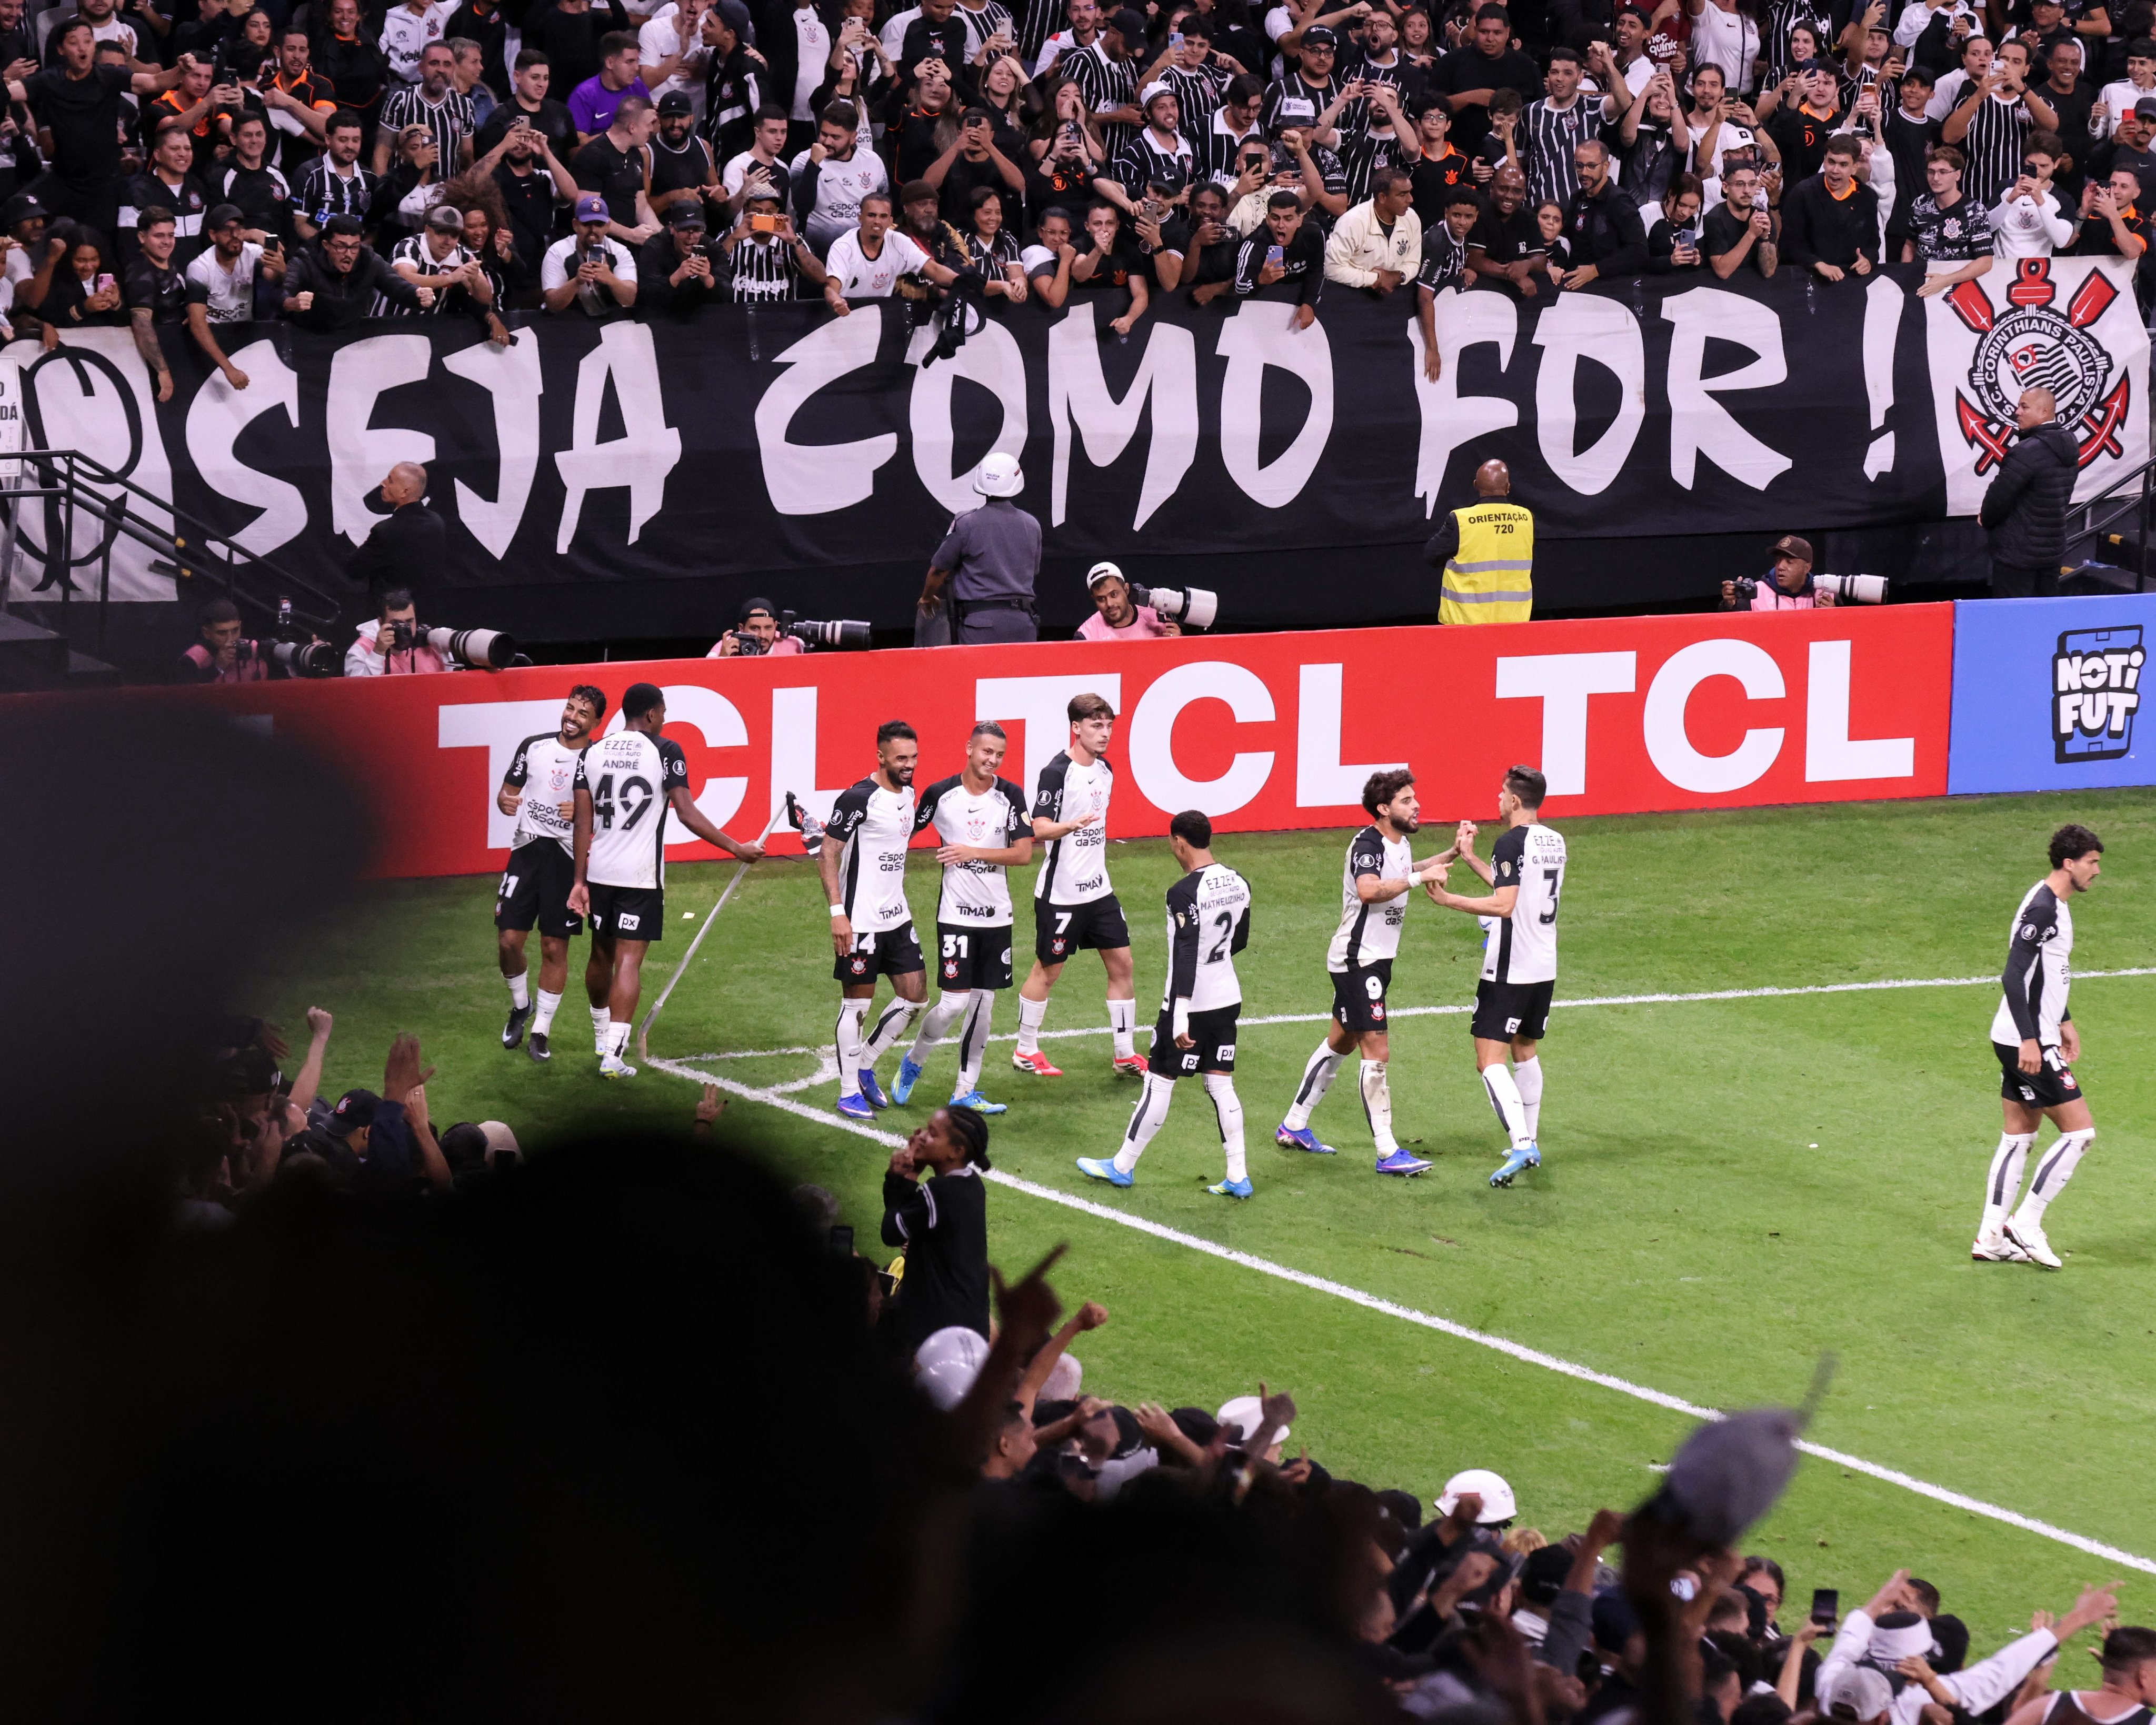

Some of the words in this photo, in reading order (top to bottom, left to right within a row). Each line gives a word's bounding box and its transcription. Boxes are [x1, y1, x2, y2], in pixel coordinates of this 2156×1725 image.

[1984, 318, 2062, 383] CORINTHIANS
[2063, 335, 2095, 405] PAULISTA
[186, 319, 682, 565] SEJA
[755, 300, 1334, 533] COMO
[1407, 286, 1793, 520] FOR
[1468, 512, 1528, 525] ORIENTAÇÃO
[1493, 524, 1514, 534] 720
[1495, 638, 1915, 796] TCL
[2059, 691, 2139, 734] FUT
[604, 740, 634, 750] EZZE
[975, 661, 1409, 834] TCL
[603, 758, 639, 770] ANDRÉ
[595, 773, 654, 831] 49
[1532, 856, 1540, 865] G.
[1206, 875, 1232, 890] EZZE
[1201, 892, 1245, 911] MATHEUZINHO
[1539, 868, 1560, 925] 3
[622, 917, 635, 929] px
[1055, 912, 1072, 934] 7
[942, 934, 968, 958] 31
[1204, 910, 1232, 965] 2
[1365, 975, 1383, 1000] 9
[1221, 1049, 1233, 1061] px
